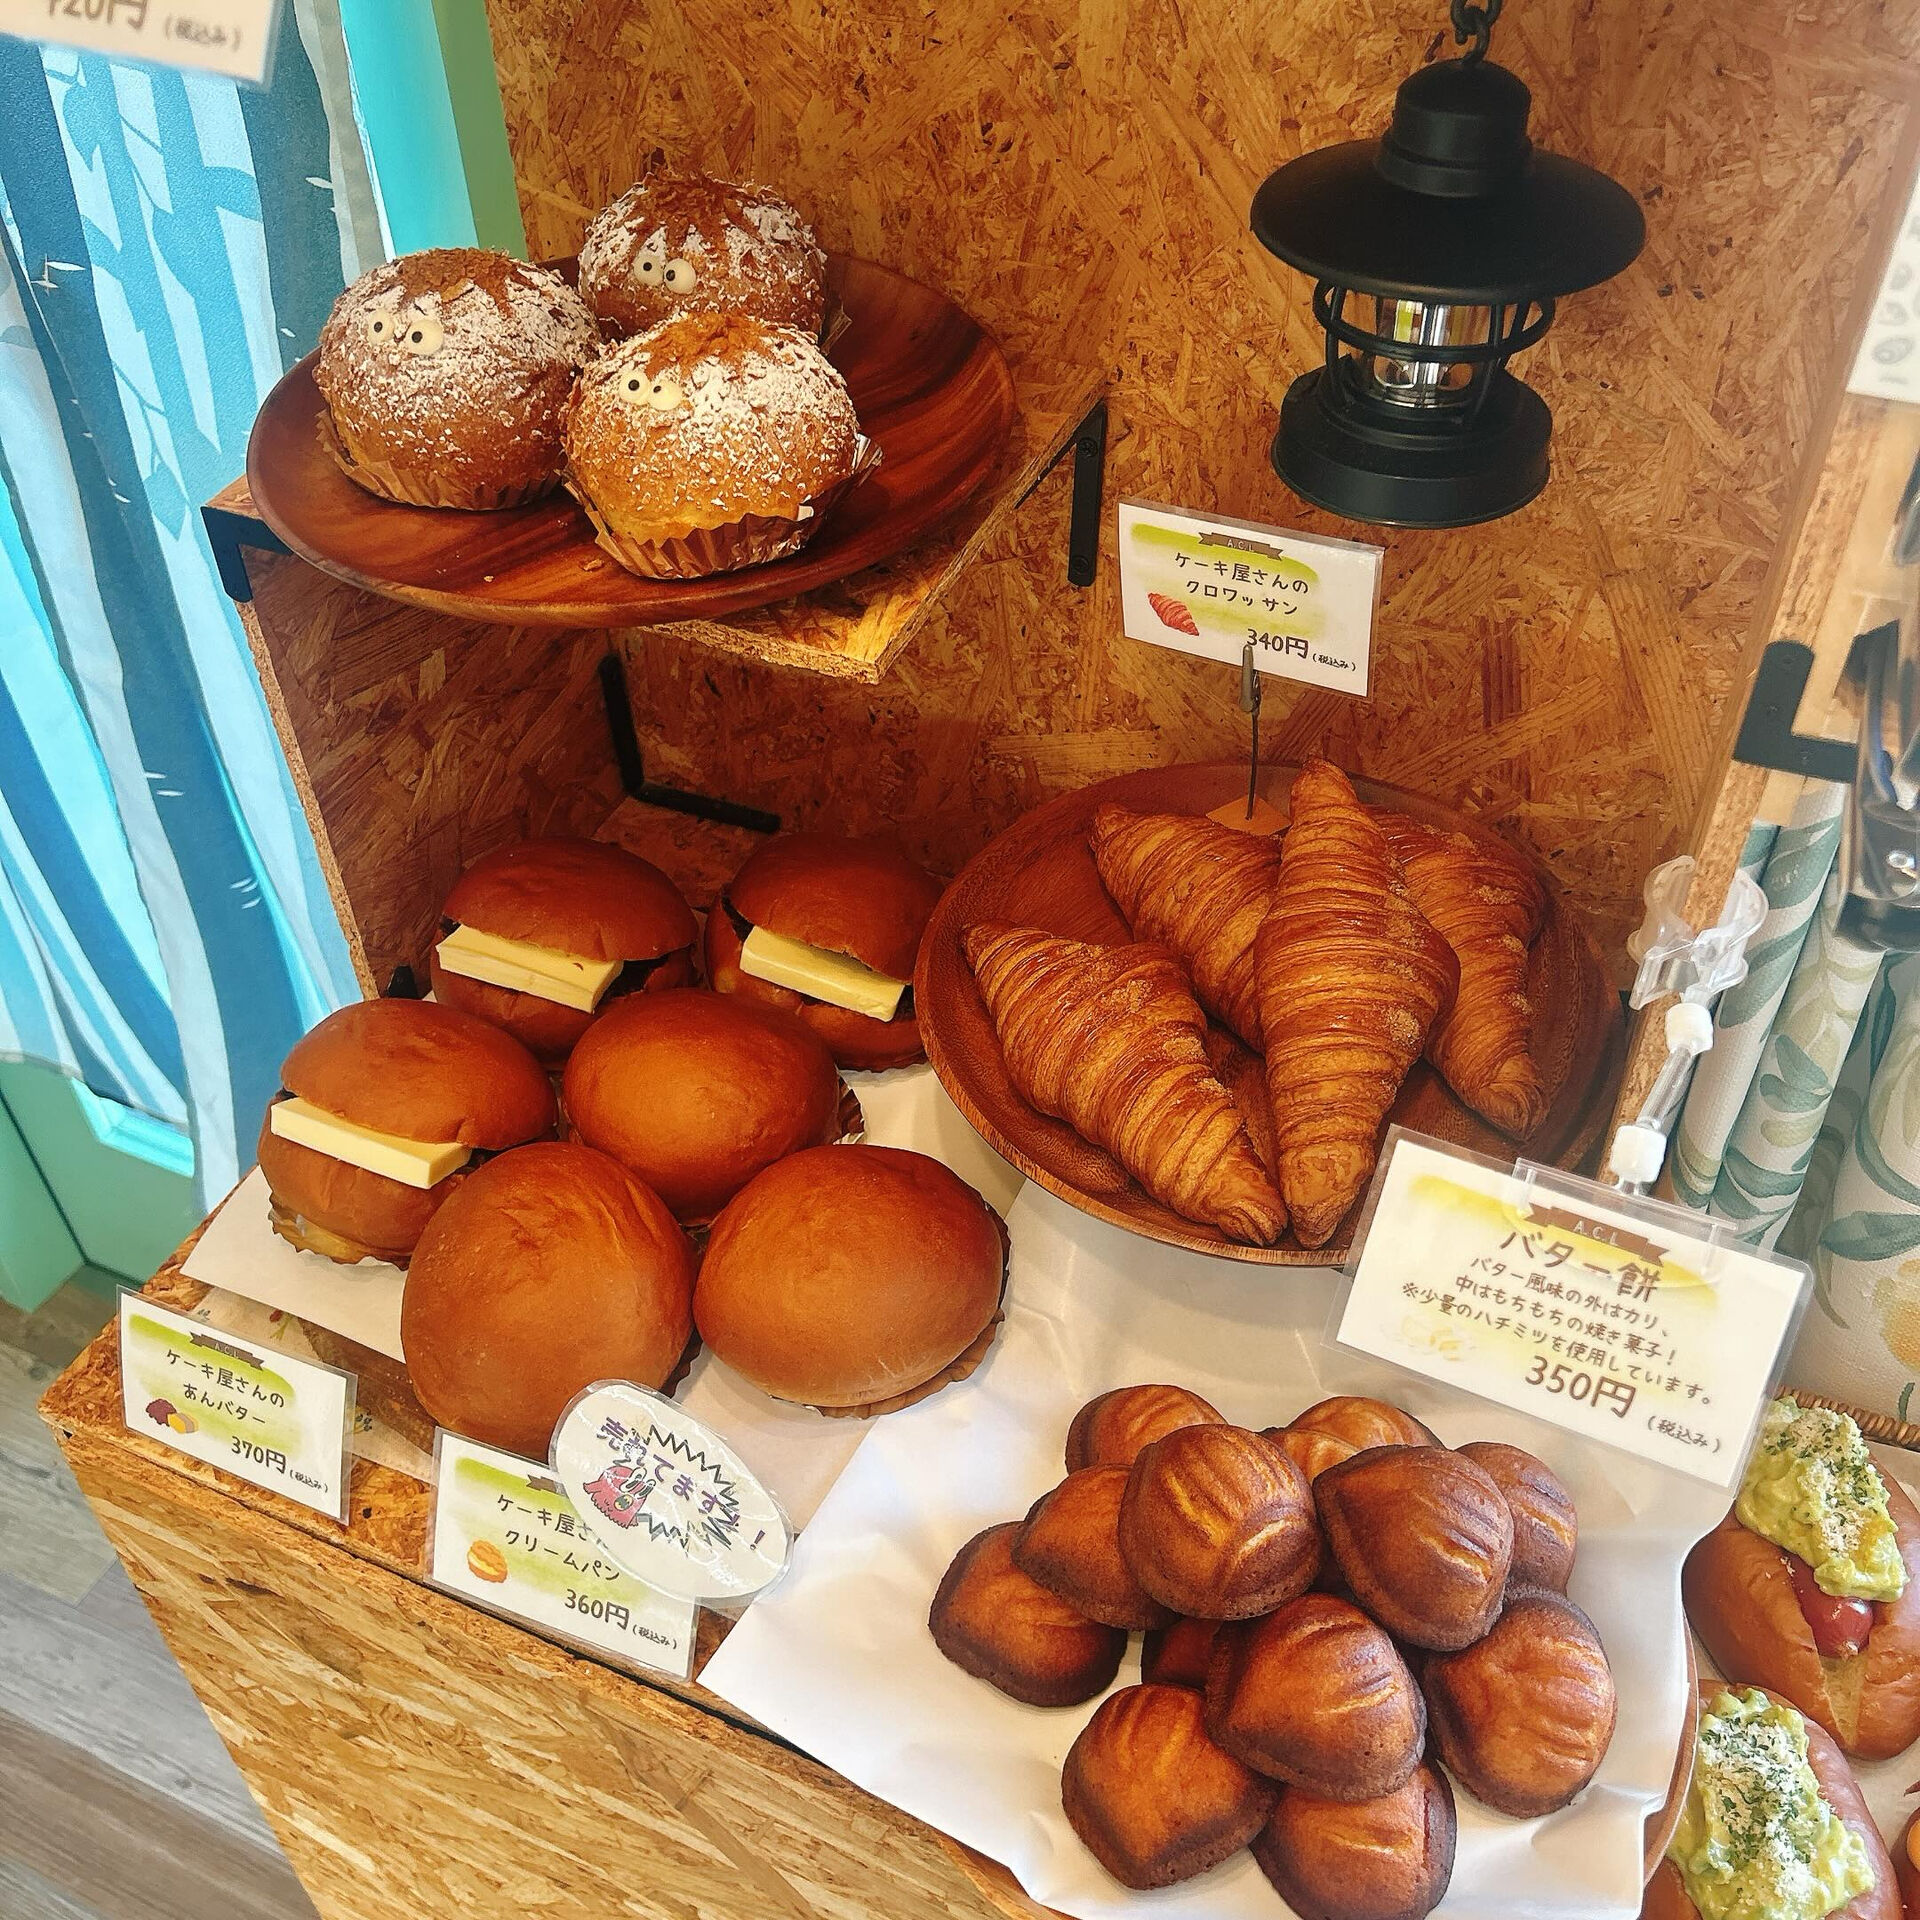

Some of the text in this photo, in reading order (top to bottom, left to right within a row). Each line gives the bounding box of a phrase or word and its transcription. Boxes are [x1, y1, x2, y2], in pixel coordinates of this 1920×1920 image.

[1174, 552, 1309, 595] ケーキ屋さんの
[1186, 580, 1299, 616] クロワッサン
[1247, 628, 1357, 672] 340円 (税込み)
[1500, 1229, 1663, 1304] バター餅
[1455, 1274, 1678, 1367] 中はもちもちの焼き菓子!
[1470, 1256, 1669, 1338] バター風味の外はカリ、
[166, 1348, 285, 1409] ケーキ屋さんの
[183, 1382, 267, 1425] あんバター
[1525, 1355, 1722, 1453] 350円 (税込み)
[231, 1435, 329, 1494] 370円 (税込み)
[505, 1529, 620, 1582] クリームパン
[564, 1588, 678, 1651] 360円 (税込み)
